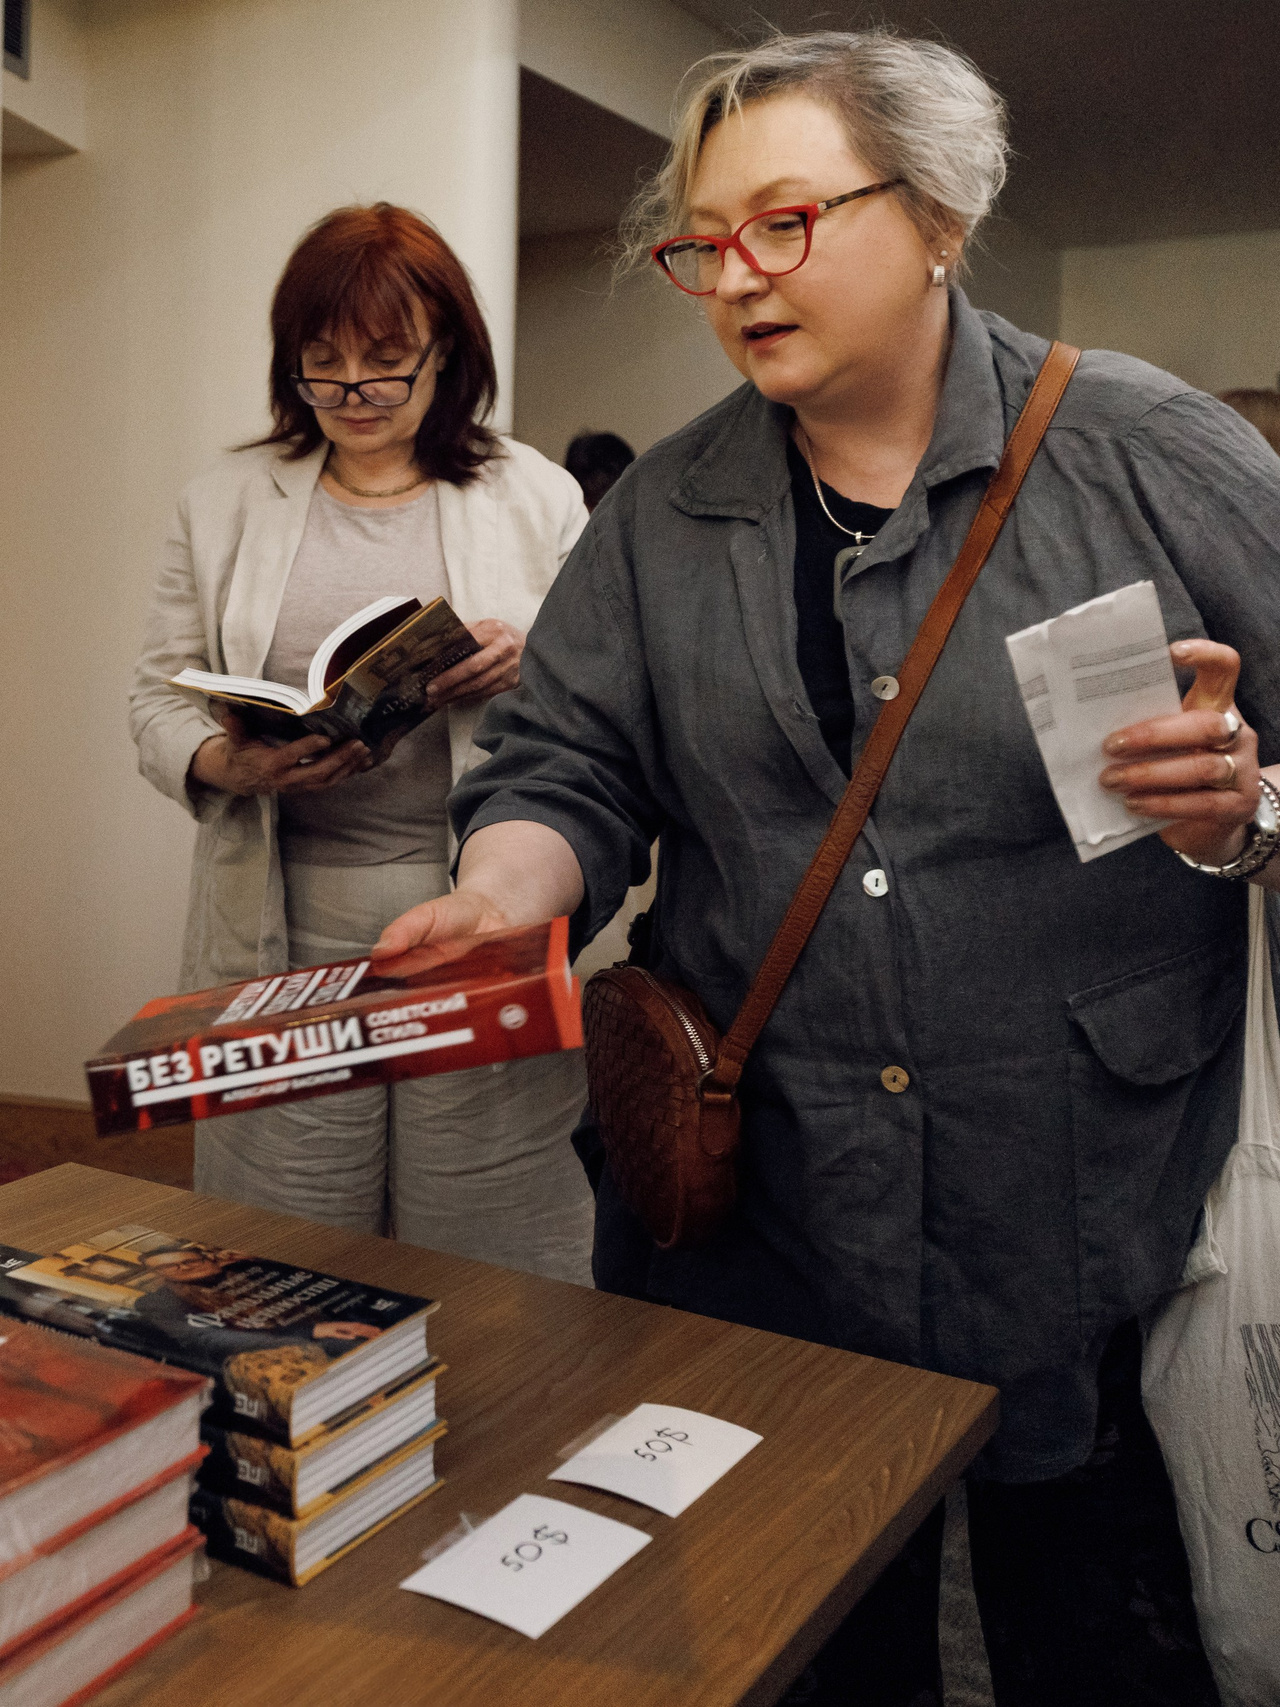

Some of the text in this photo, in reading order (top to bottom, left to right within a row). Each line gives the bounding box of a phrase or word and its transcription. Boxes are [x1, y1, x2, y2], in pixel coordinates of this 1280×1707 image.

[366, 993, 468, 1028] СОВЕТСКИЙ
[127, 1016, 363, 1092] БЕЗ РЕТУШИ
[369, 1021, 427, 1046] СТИЛЬ
[502, 1524, 569, 1572] 50$
